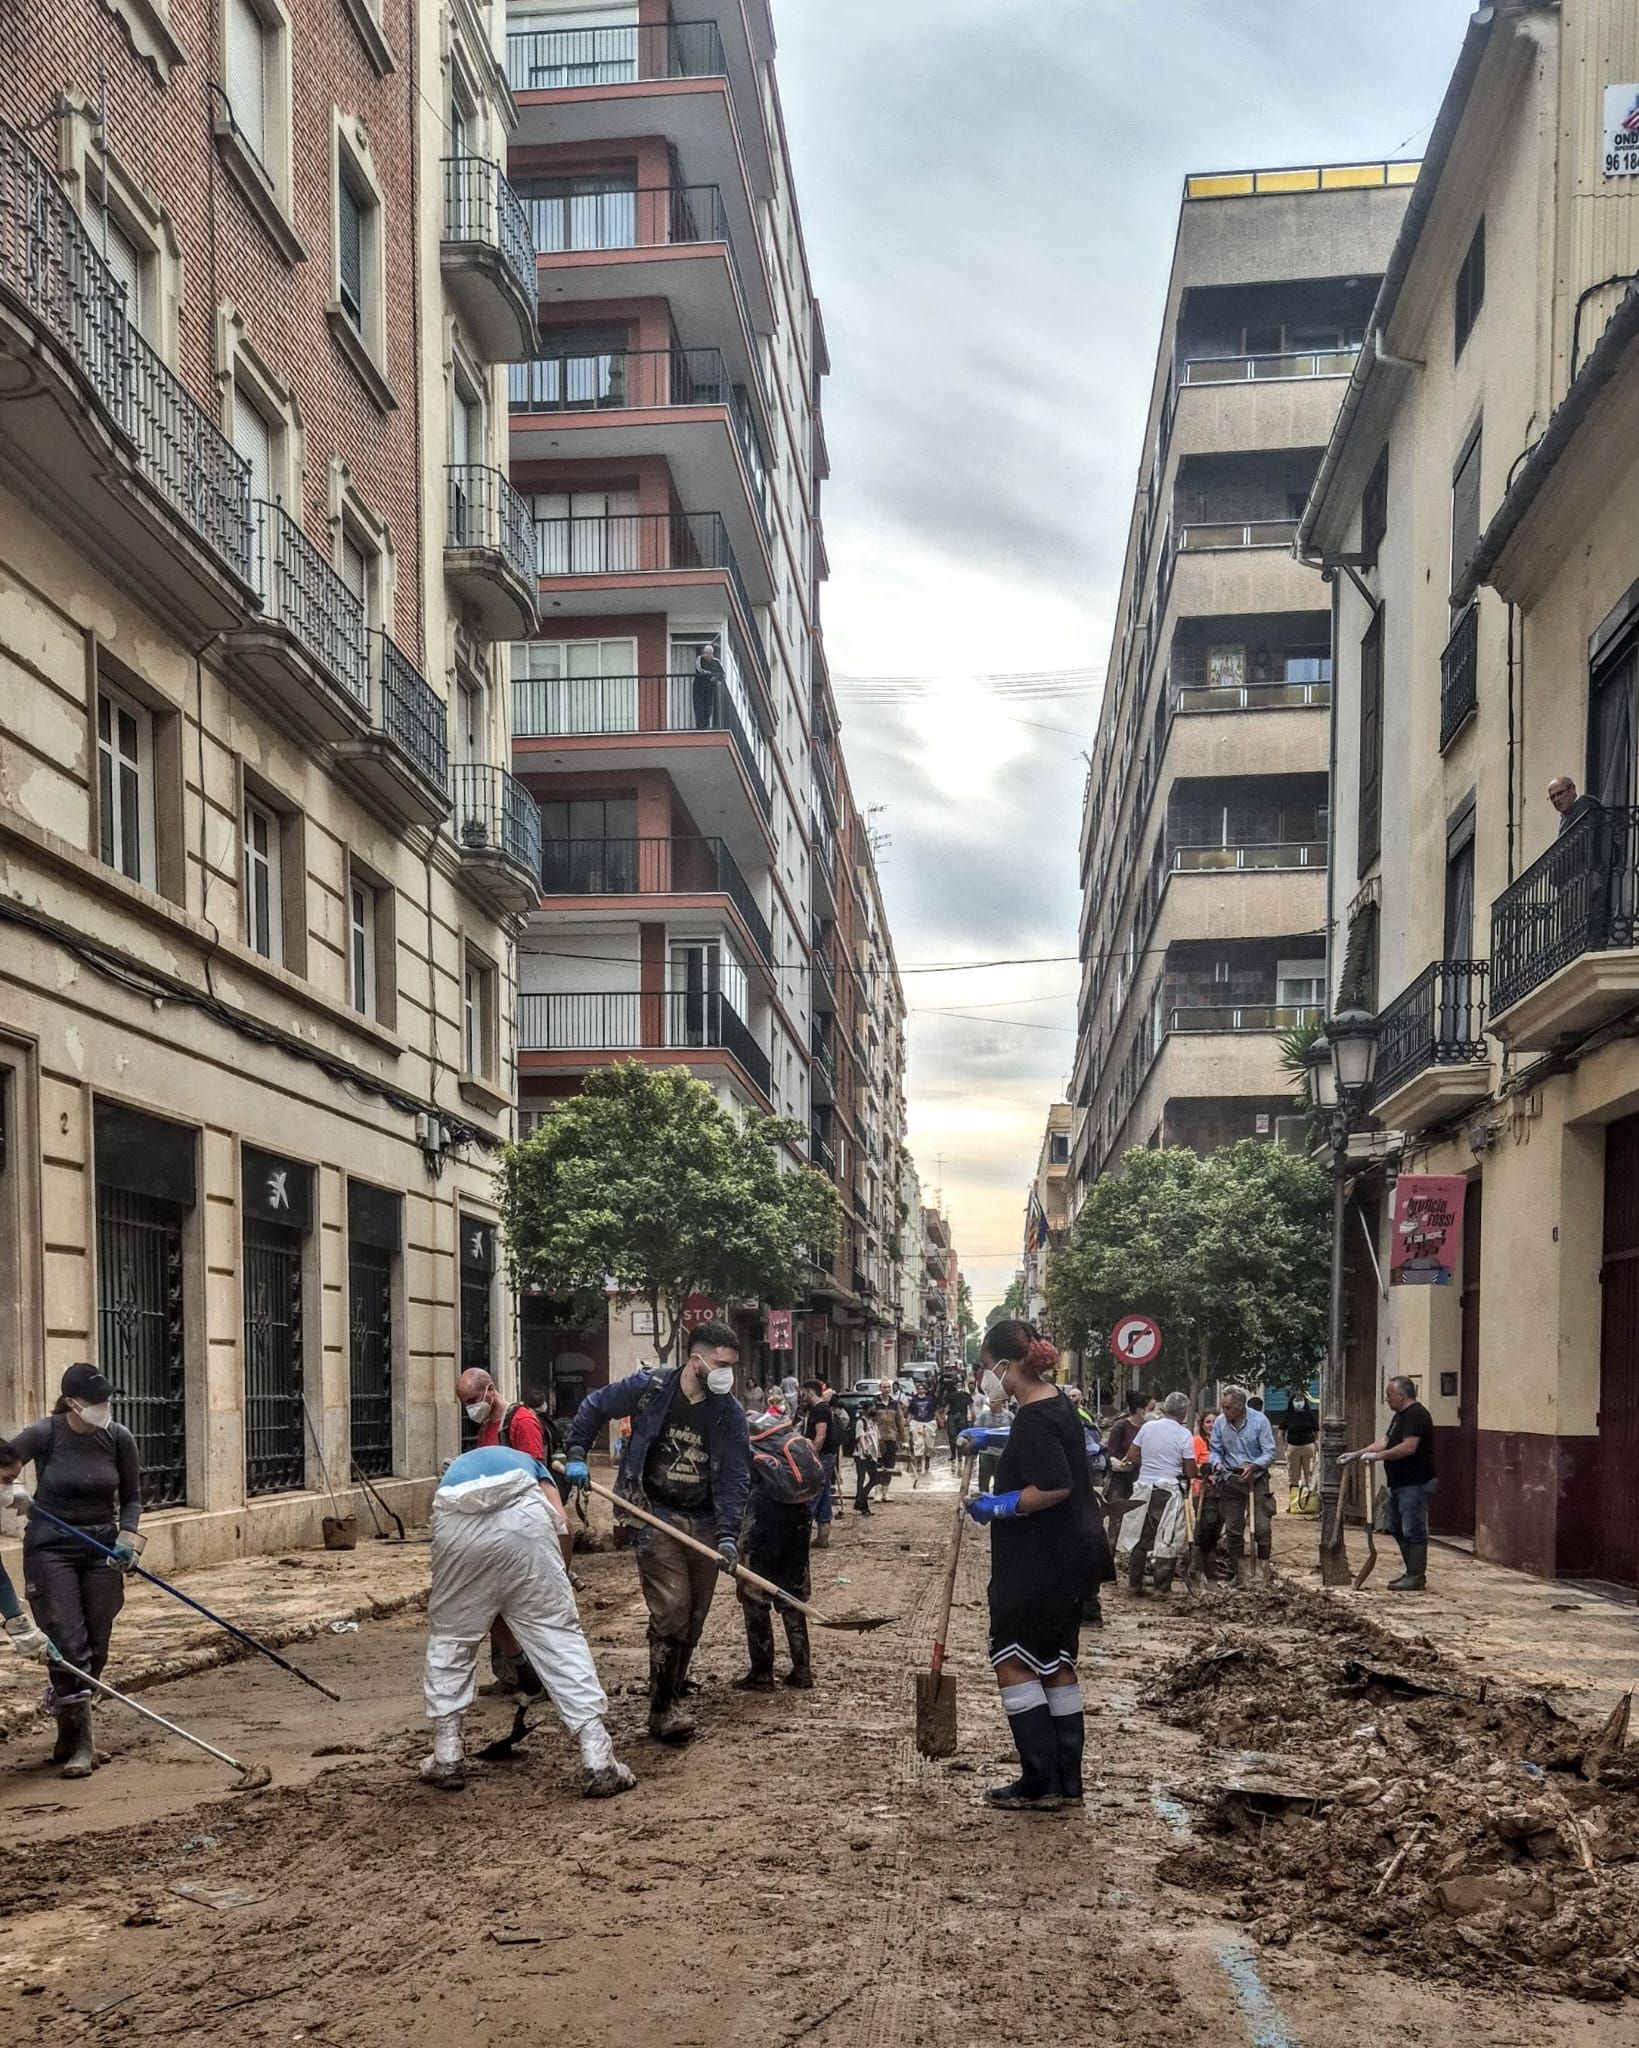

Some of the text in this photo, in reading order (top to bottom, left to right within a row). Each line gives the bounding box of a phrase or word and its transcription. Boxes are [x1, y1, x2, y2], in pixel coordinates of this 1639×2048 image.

[1606, 152, 1639, 171] 96 18
[60, 1111, 69, 1136] 2
[683, 1308, 722, 1321] STO
